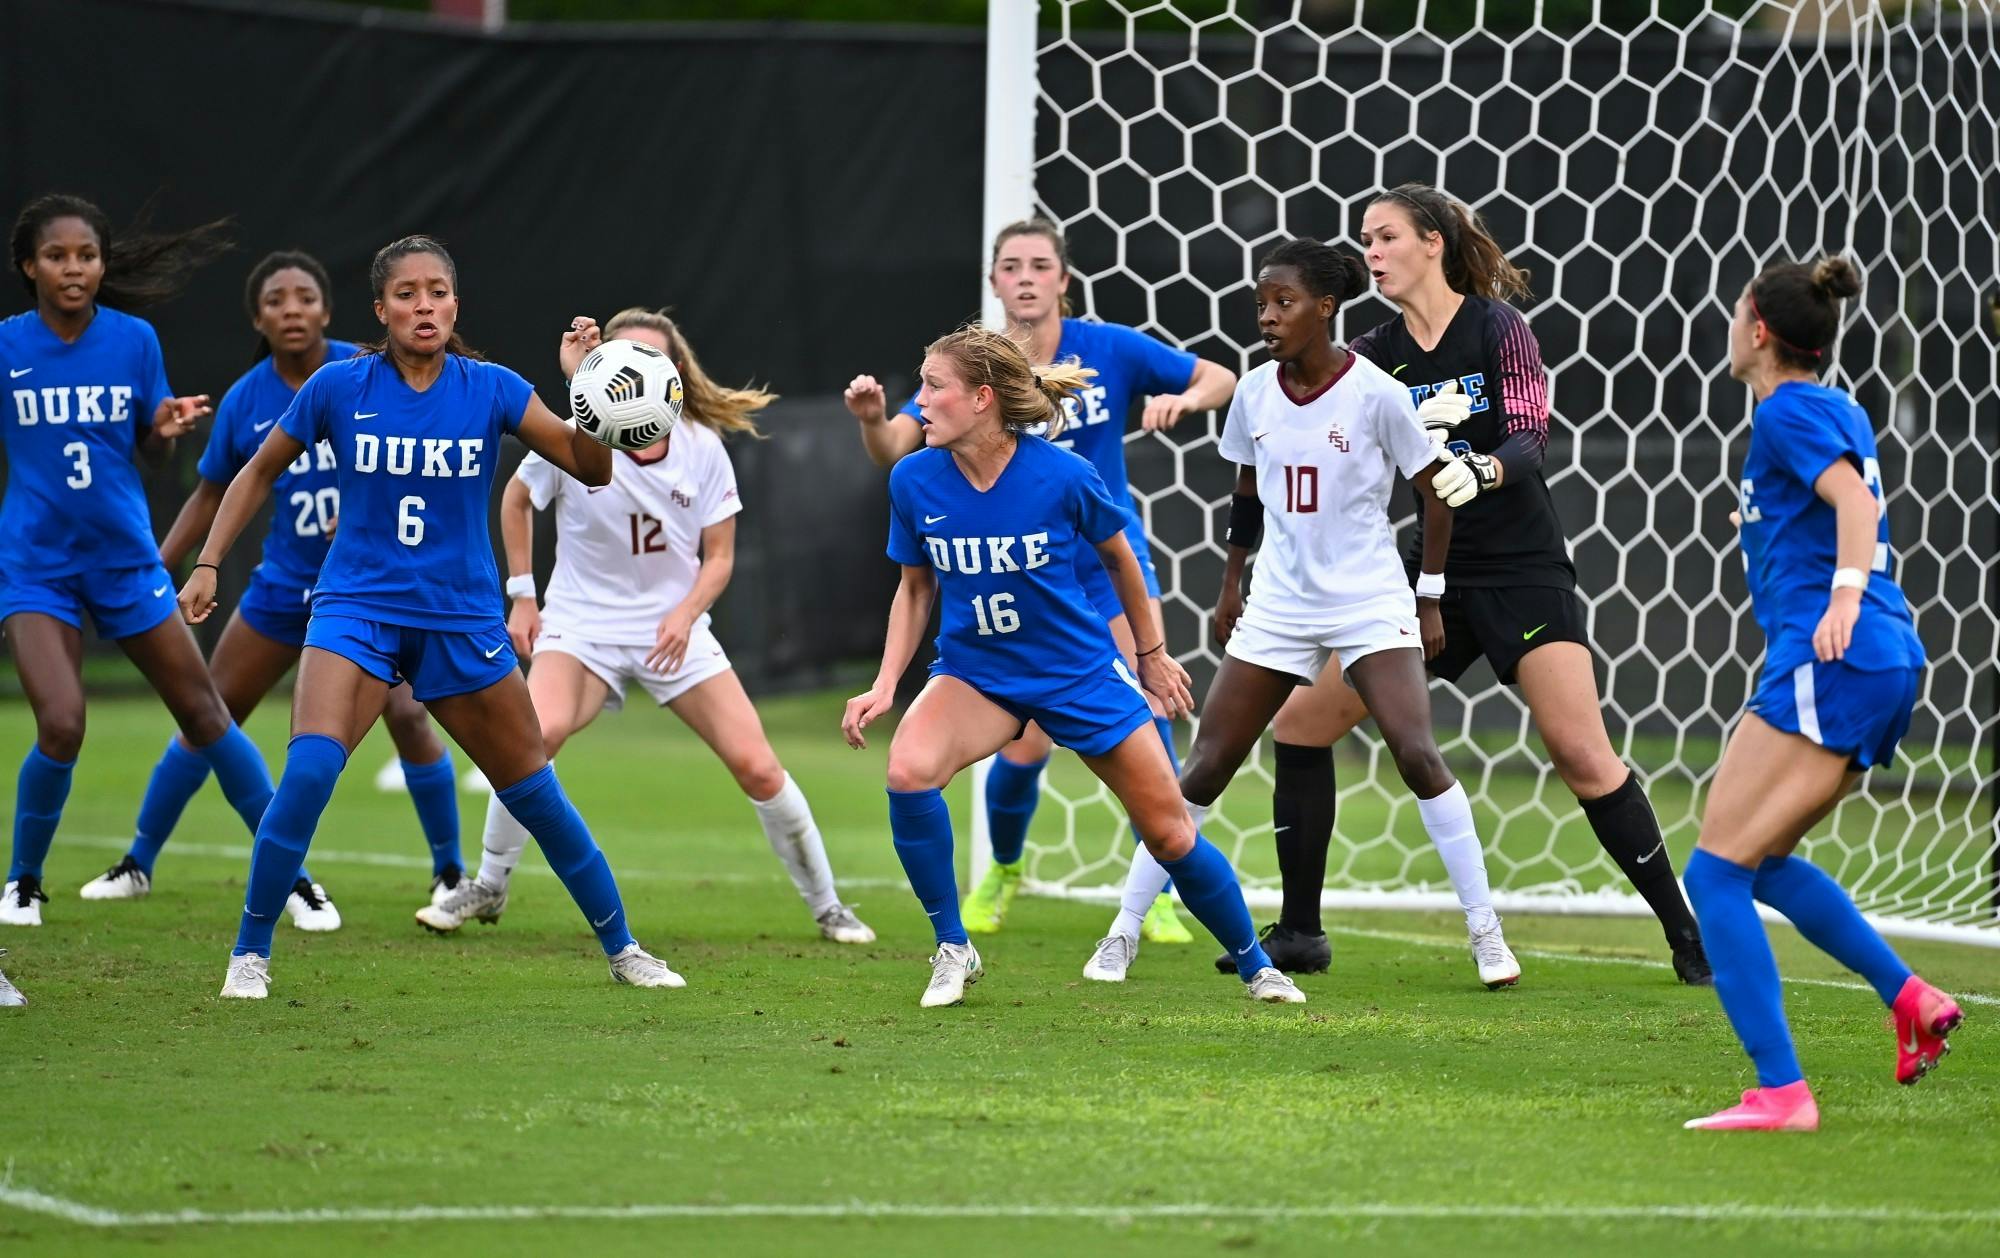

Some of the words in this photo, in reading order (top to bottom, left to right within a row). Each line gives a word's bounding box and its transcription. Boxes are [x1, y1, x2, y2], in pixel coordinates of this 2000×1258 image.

[13, 386, 132, 426] DUKE
[355, 433, 484, 478] DUKE
[1328, 431, 1349, 453] FSU
[63, 441, 92, 490] 3
[670, 489, 690, 508] FSU
[1284, 465, 1318, 513] 10
[290, 487, 340, 537] 20
[397, 495, 426, 546] 6
[628, 513, 667, 555] 12
[925, 532, 1050, 575] DUKE
[971, 592, 1021, 636] 16
